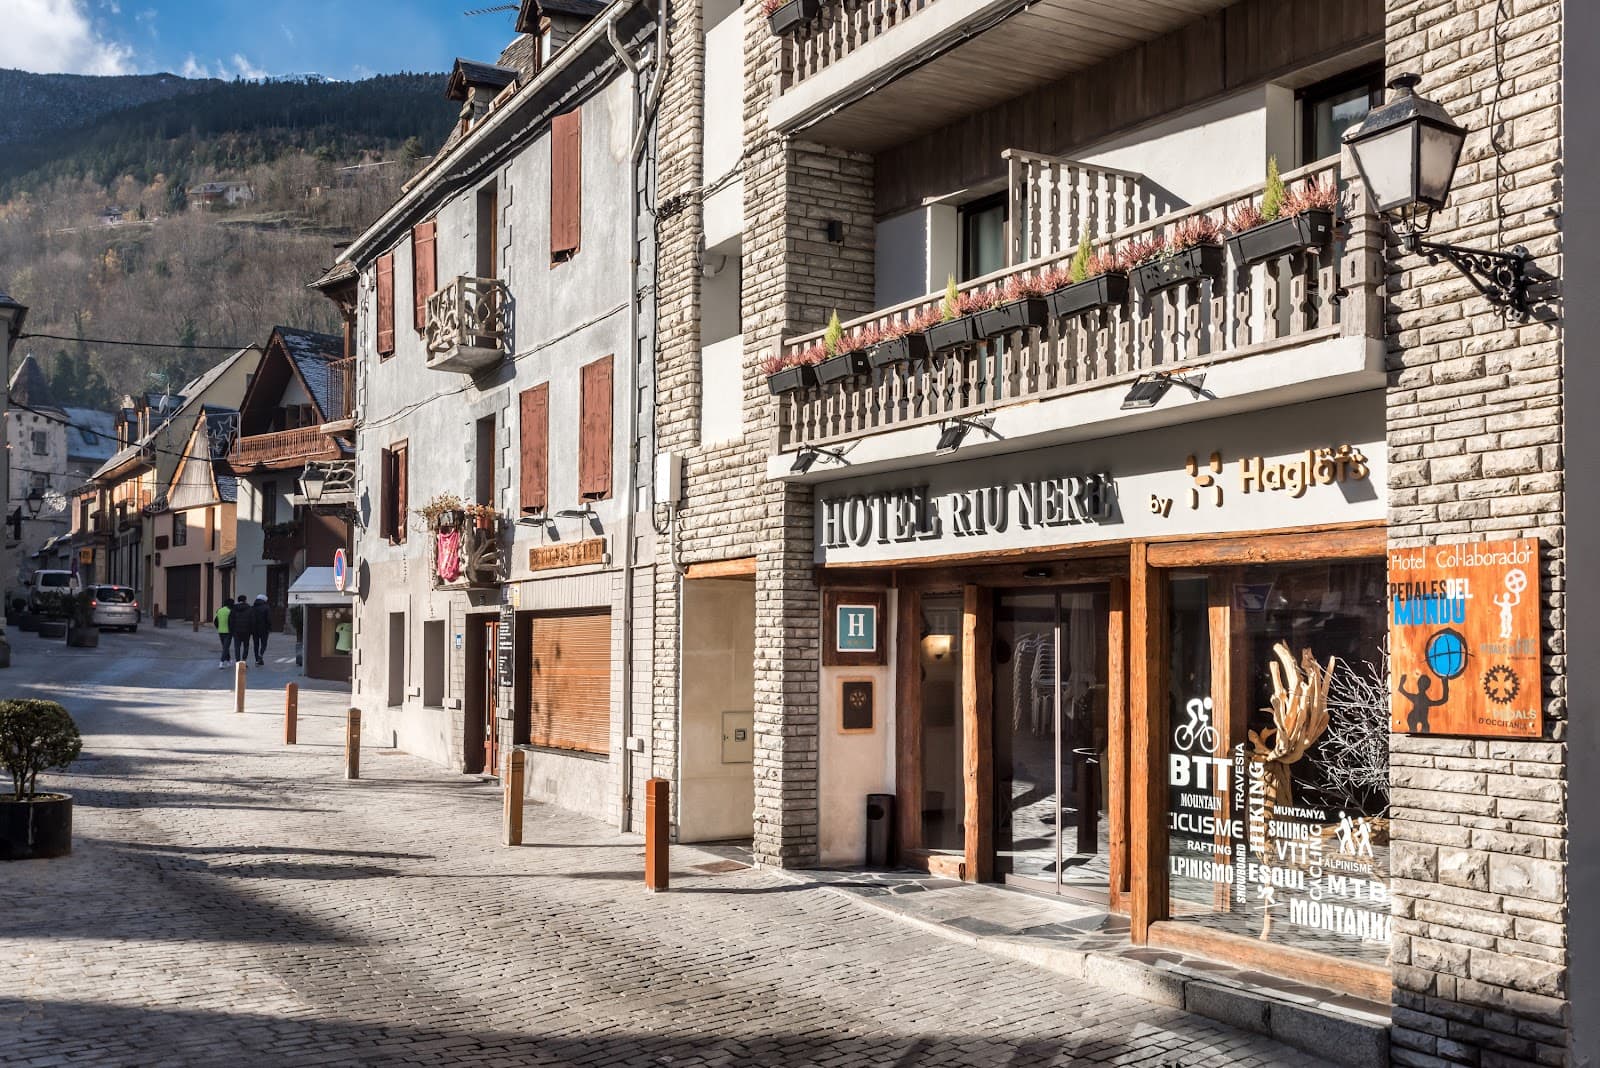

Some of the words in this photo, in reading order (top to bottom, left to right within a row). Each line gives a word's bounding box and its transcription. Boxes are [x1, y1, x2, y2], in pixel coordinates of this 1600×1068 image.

[821, 485, 942, 548] HOTEL
[947, 485, 1006, 536] RIU
[1014, 472, 1120, 531] NERE
[1150, 494, 1173, 518] by
[1239, 445, 1369, 498] Haglöfs
[1391, 547, 1426, 570] Hotel
[1393, 593, 1466, 626] MUNDO
[847, 613, 865, 637] H
[1170, 753, 1233, 791] BTT
[1235, 742, 1245, 811] TRAVESIA
[1180, 793, 1222, 811] MOUNTAIN
[1249, 761, 1265, 854] HIKING
[1273, 805, 1327, 821] MUNTANYA
[1268, 820, 1309, 841] SKIING
[1187, 840, 1232, 856] RAFTING
[1275, 839, 1309, 865] VTT
[1170, 855, 1234, 884] LPINISMO
[1236, 843, 1247, 904] SNOWBOARD
[1248, 863, 1304, 890] ESQUI
[1324, 858, 1373, 874] ALPINISME
[1327, 874, 1388, 903] MTB
